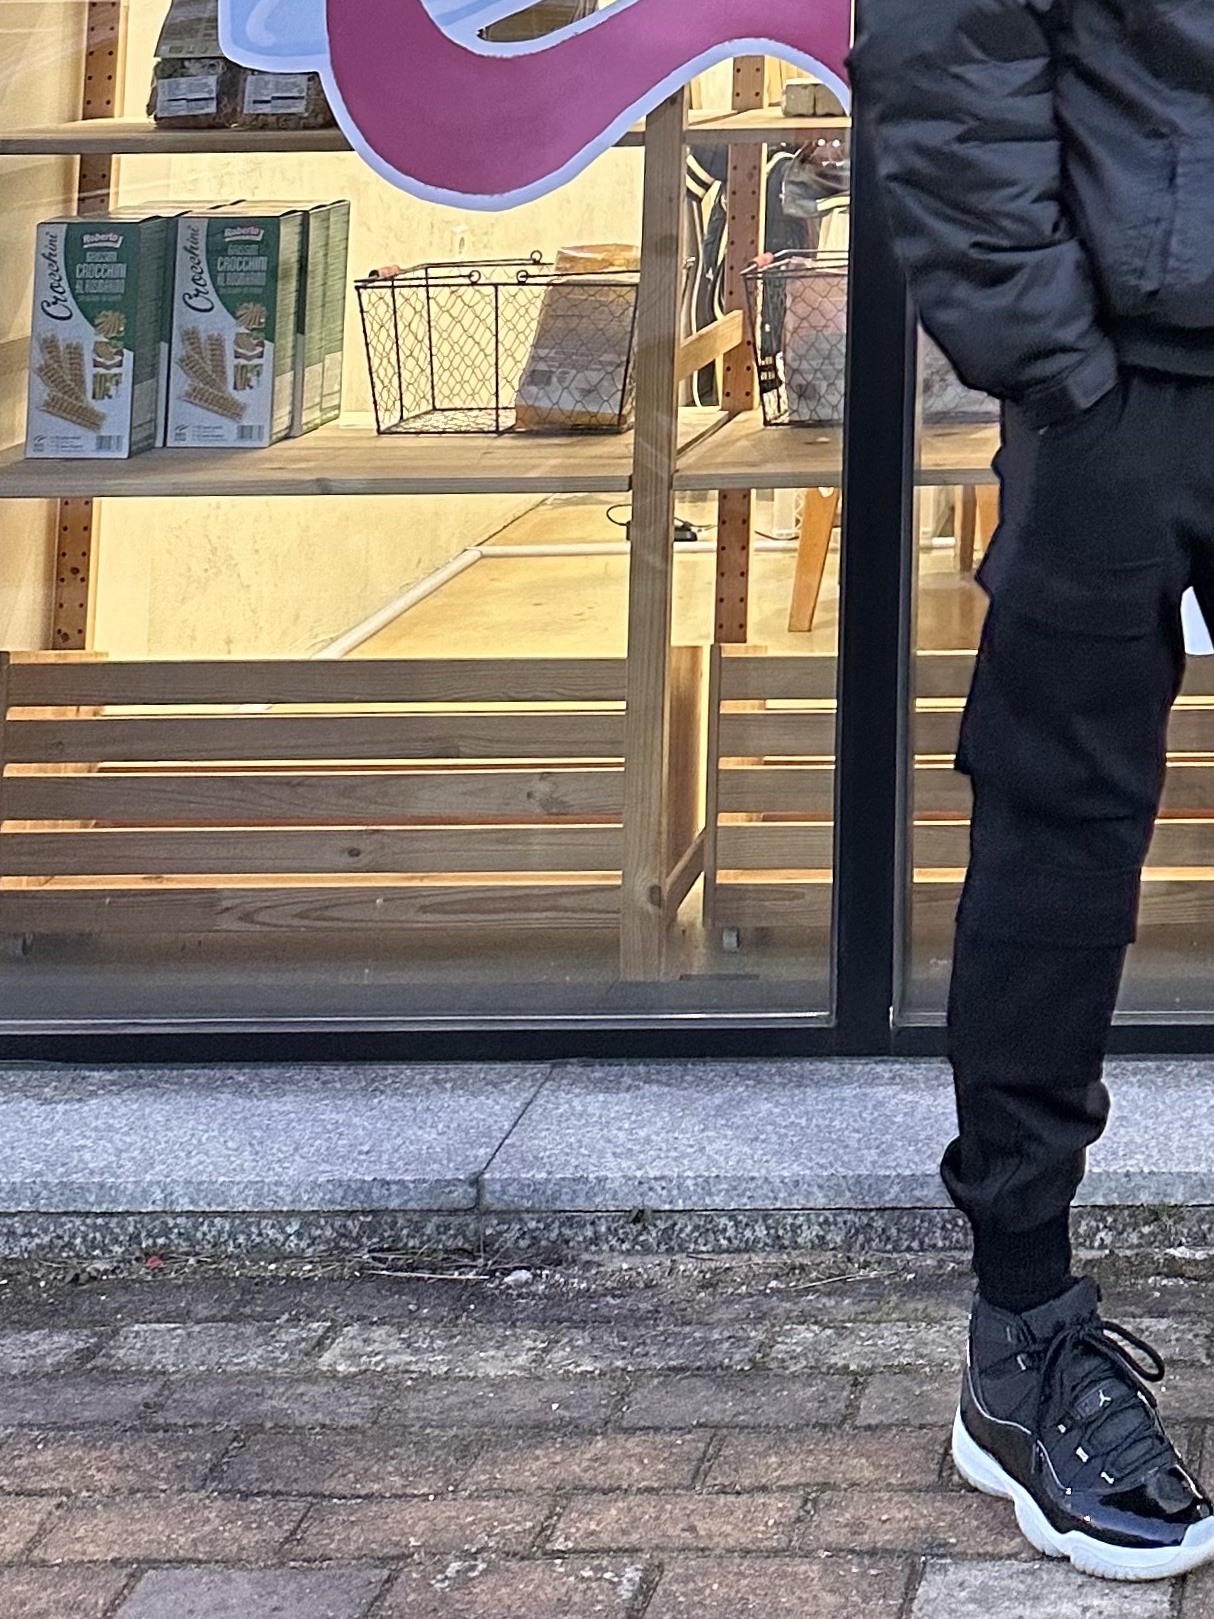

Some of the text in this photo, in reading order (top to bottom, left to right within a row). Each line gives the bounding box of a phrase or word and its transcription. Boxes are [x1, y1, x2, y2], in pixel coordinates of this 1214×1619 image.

[83, 232, 120, 244] Roberto
[224, 226, 260, 238] Roberto
[41, 231, 73, 321] Crocchini
[182, 224, 214, 313] Crocchini
